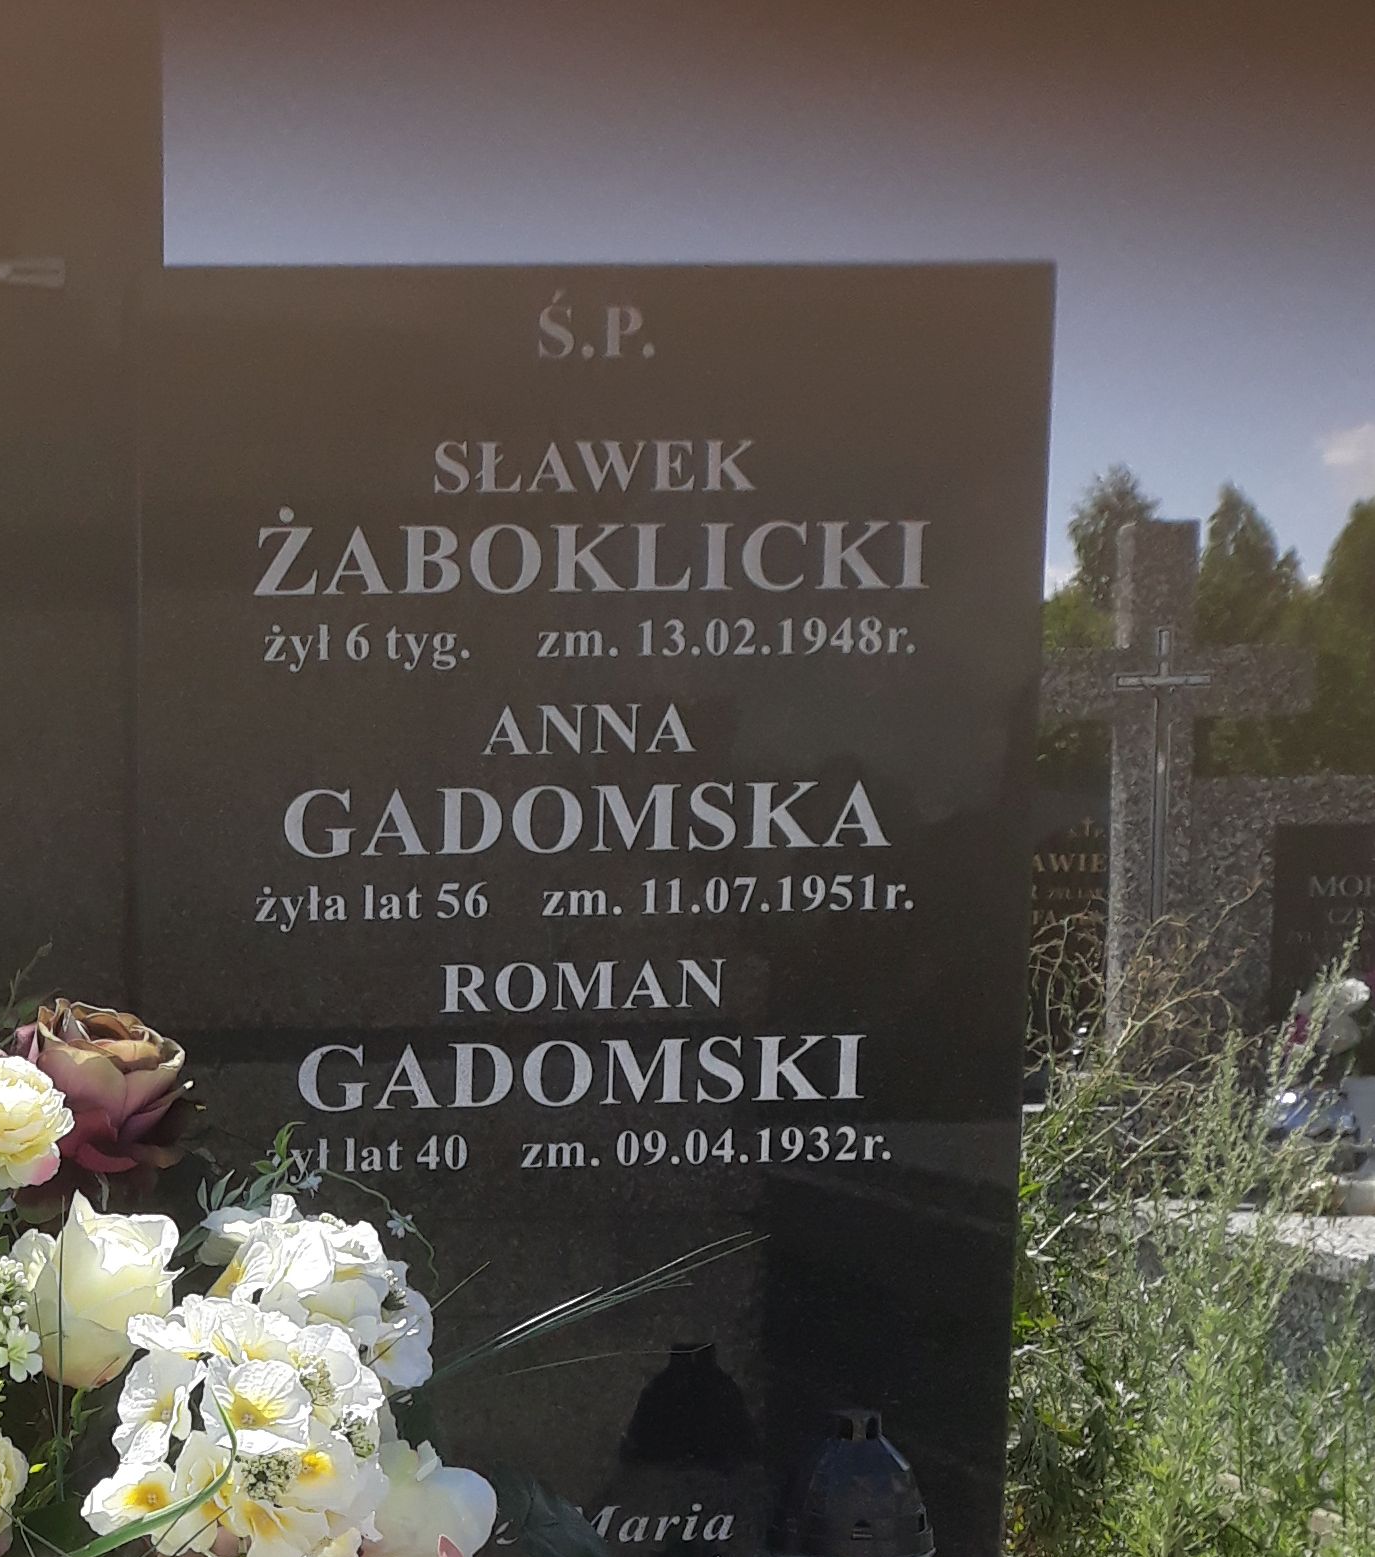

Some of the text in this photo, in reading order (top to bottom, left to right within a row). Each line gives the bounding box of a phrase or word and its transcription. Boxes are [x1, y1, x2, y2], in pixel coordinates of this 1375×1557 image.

[538, 288, 656, 360] Ś.P.
[433, 439, 756, 495] SŁAWEK
[253, 507, 932, 597] ŻABOKLICKI
[263, 616, 916, 673] żył 6 tyg. zm. 13.02.1948r.
[481, 703, 697, 756] ANNA
[282, 780, 892, 860] GADOMSKA
[254, 874, 915, 933] żyła lat 56 zm. 11.07.1951r.
[439, 958, 727, 1014] ROMAN
[297, 1034, 867, 1113] GADOMSKI
[344, 1136, 404, 1173] lat
[416, 1134, 469, 1171] 40
[520, 1140, 601, 1169] zm.
[616, 1125, 892, 1167] 09.04.1932r.
